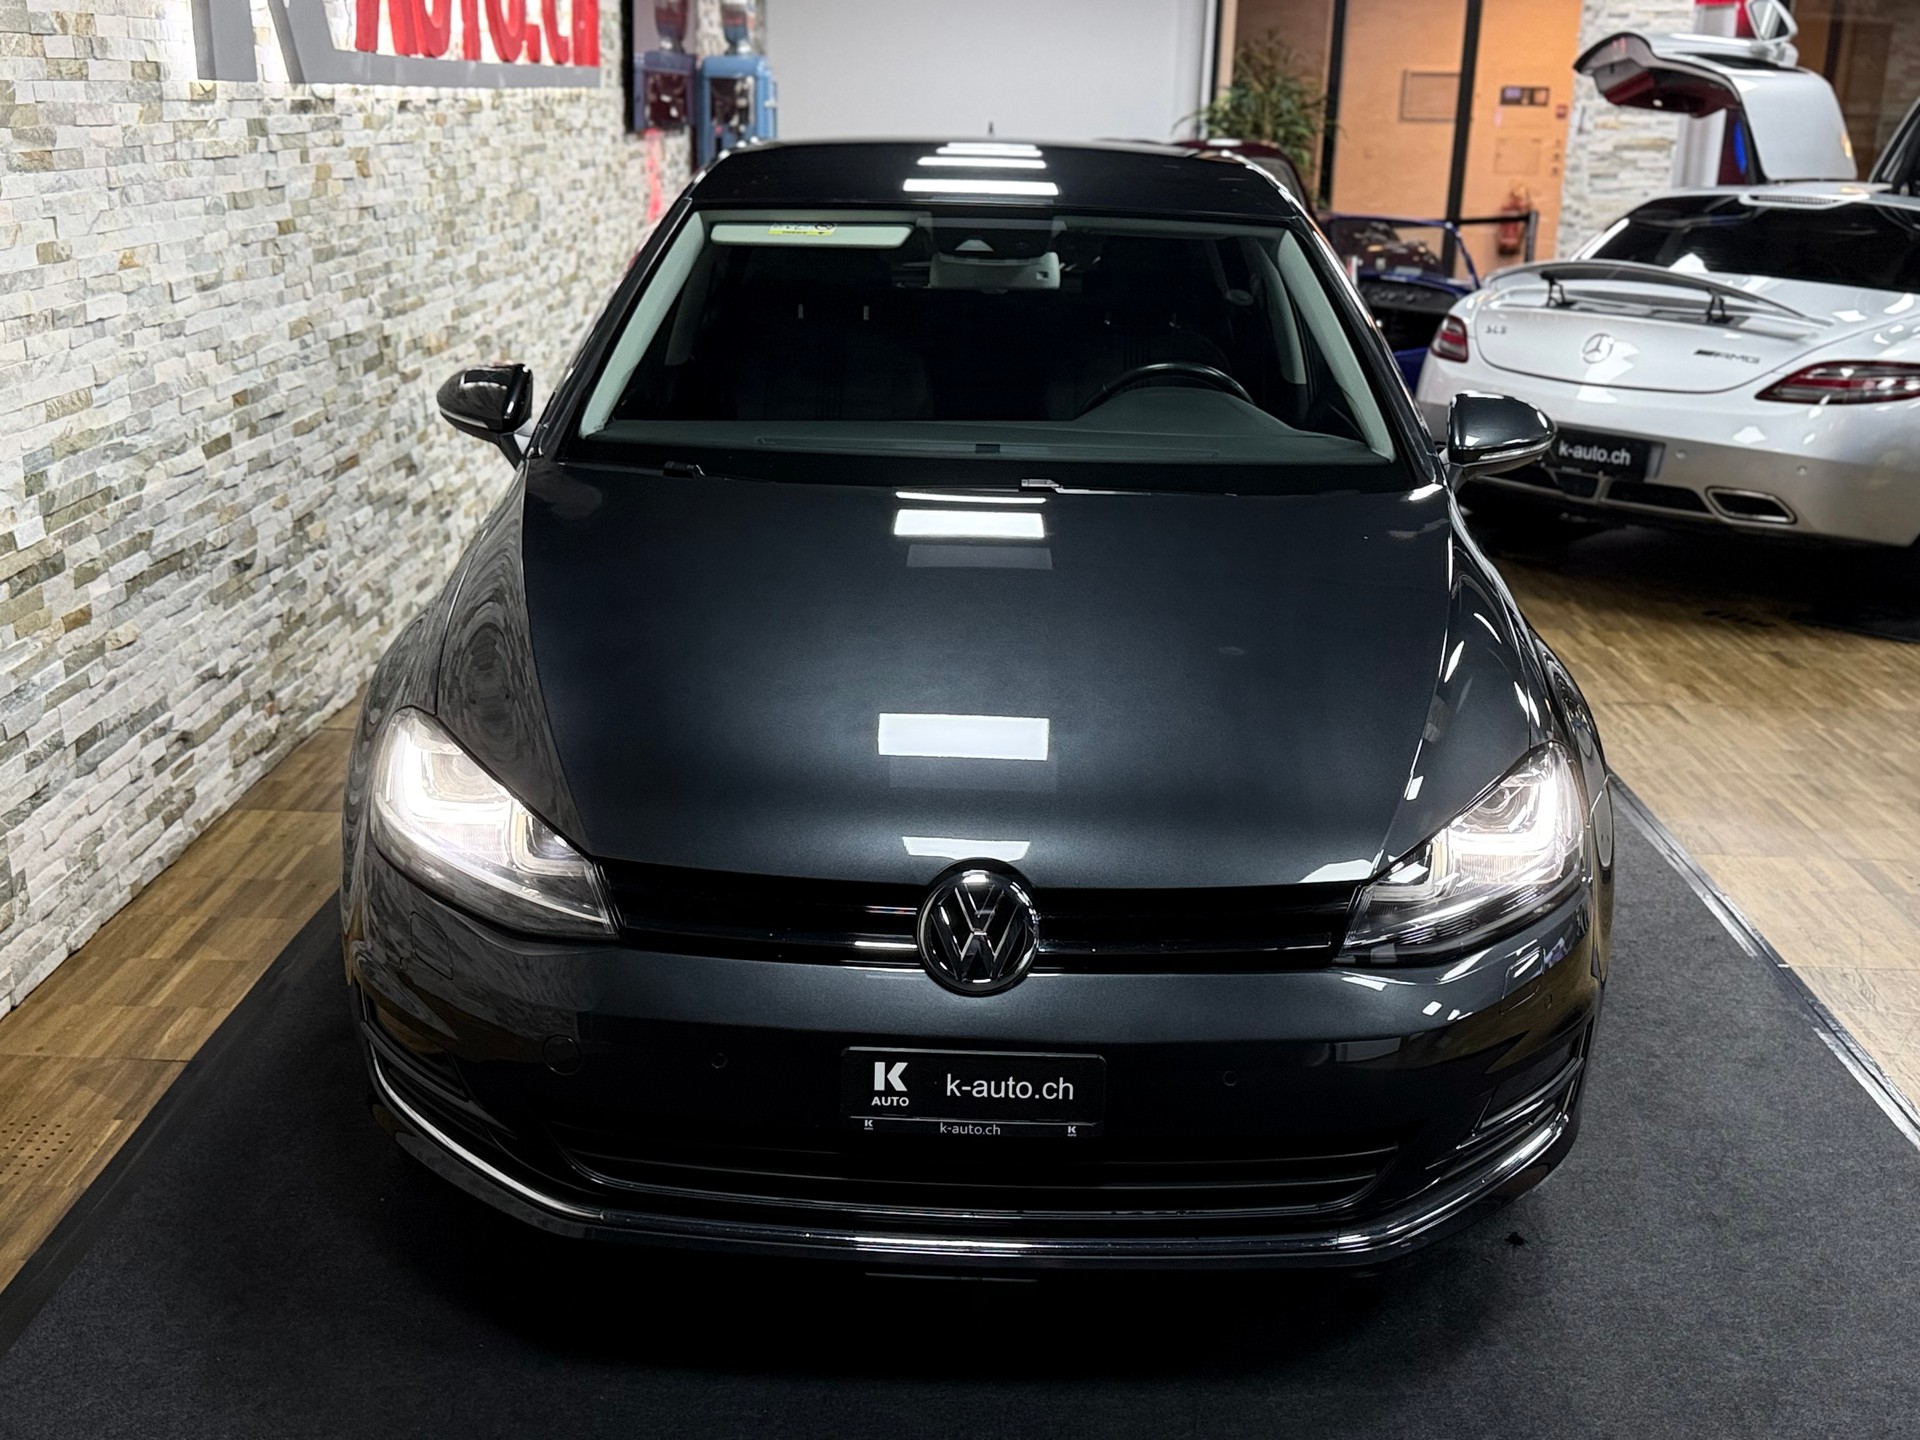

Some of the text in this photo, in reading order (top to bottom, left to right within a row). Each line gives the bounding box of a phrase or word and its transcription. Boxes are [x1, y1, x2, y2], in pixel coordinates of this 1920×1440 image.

[1558, 439, 1631, 466] k-auto.ch
[874, 1062, 908, 1091] K
[946, 1073, 1074, 1100] k-auto.ch
[871, 1096, 910, 1107] AUTO
[939, 1121, 1001, 1136] k-auto.ch
